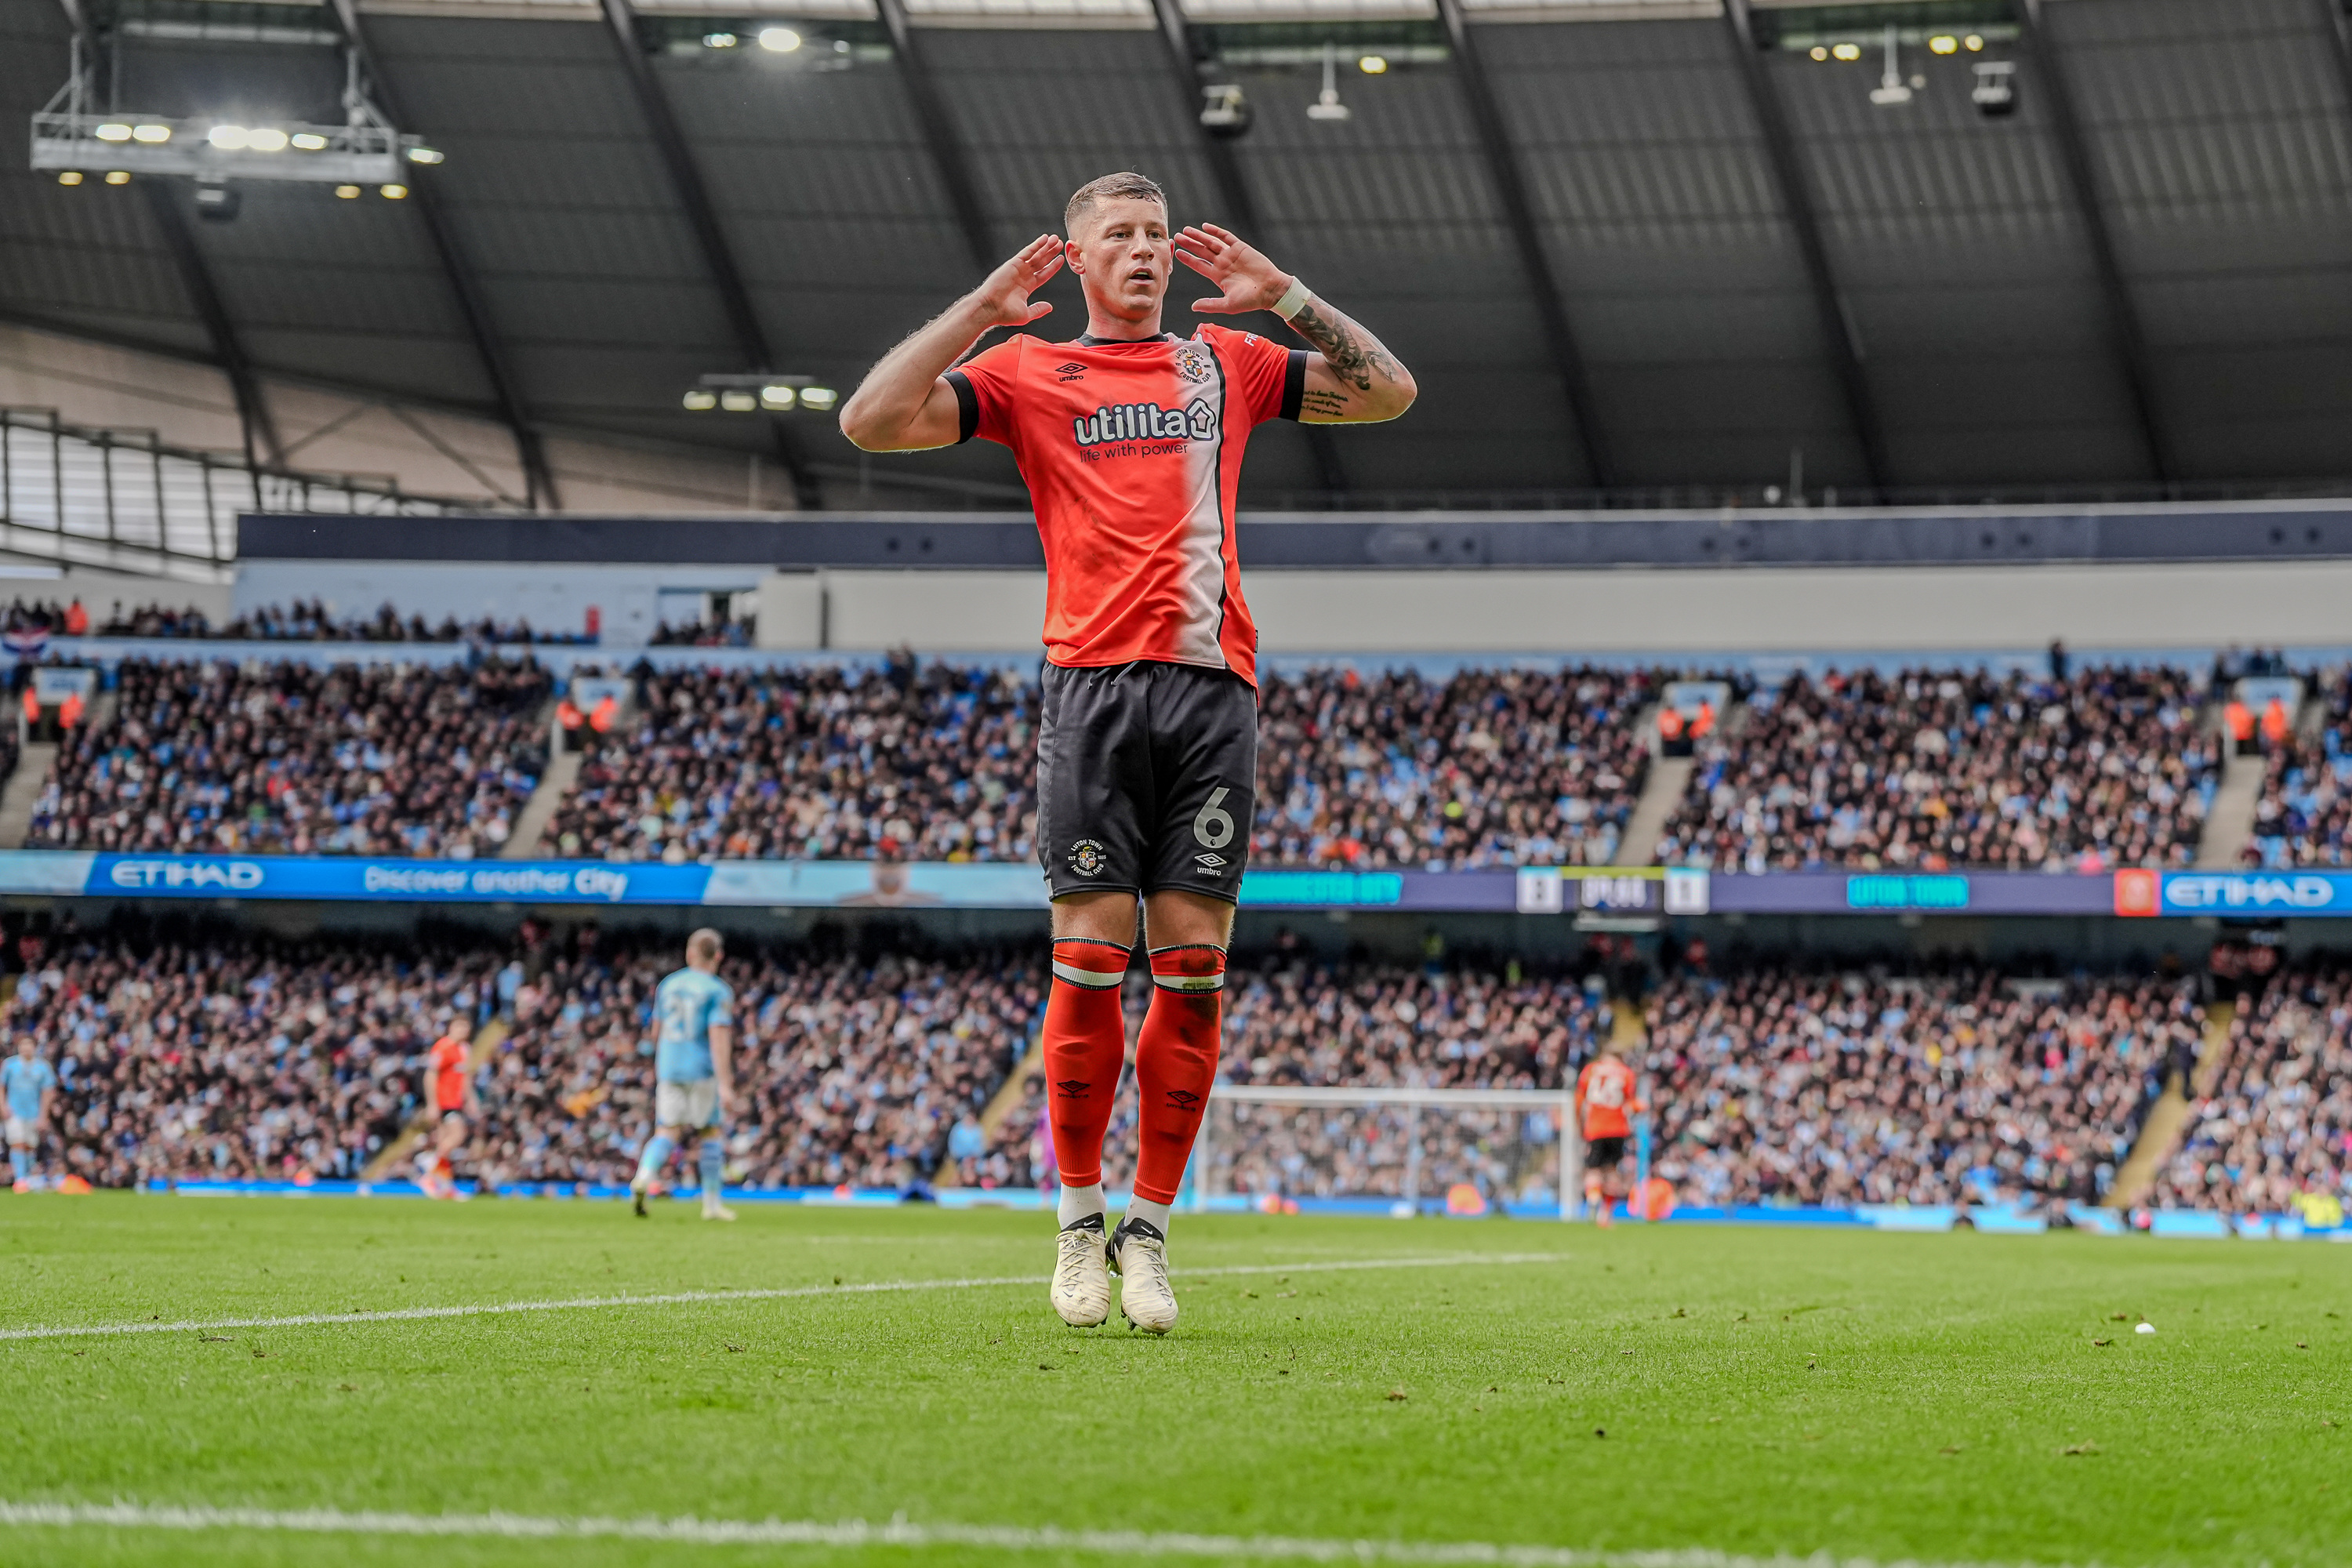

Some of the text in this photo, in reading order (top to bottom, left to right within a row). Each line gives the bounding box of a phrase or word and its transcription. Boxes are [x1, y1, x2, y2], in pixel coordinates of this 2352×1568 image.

[1074, 402, 1189, 446] utilita
[1080, 443, 1188, 463] life with power
[1193, 786, 1234, 849] 6
[1070, 839, 1104, 851] LUTON TOWN
[111, 860, 265, 890] ETIHAD
[365, 866, 628, 902] Discover another City
[1071, 863, 1105, 877] FOOTBALL CLUB
[1196, 866, 1221, 877] umbro
[2165, 875, 2335, 907] ETIHAD
